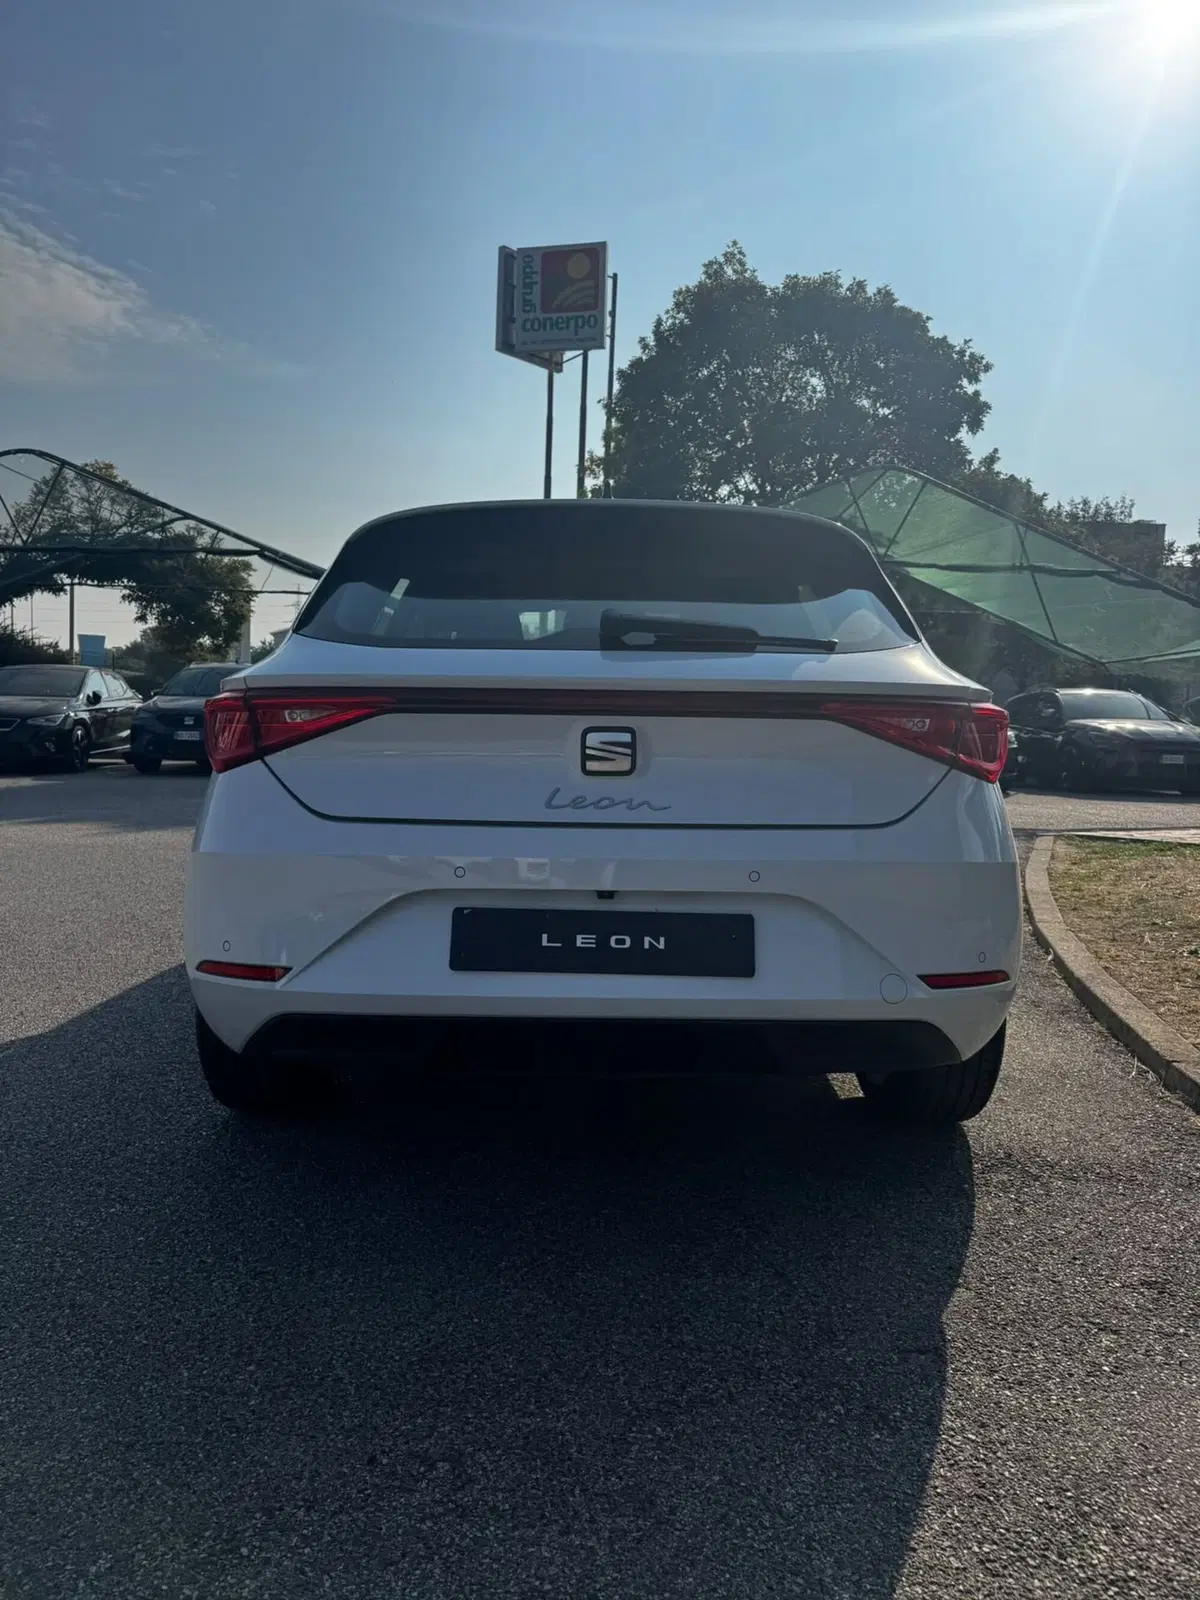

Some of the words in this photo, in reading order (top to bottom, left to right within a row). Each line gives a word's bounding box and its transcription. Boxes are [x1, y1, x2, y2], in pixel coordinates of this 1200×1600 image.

[521, 254, 538, 313] gruppo
[521, 314, 598, 336] conerpo
[544, 786, 672, 811] Leon
[541, 933, 665, 949] LEON
